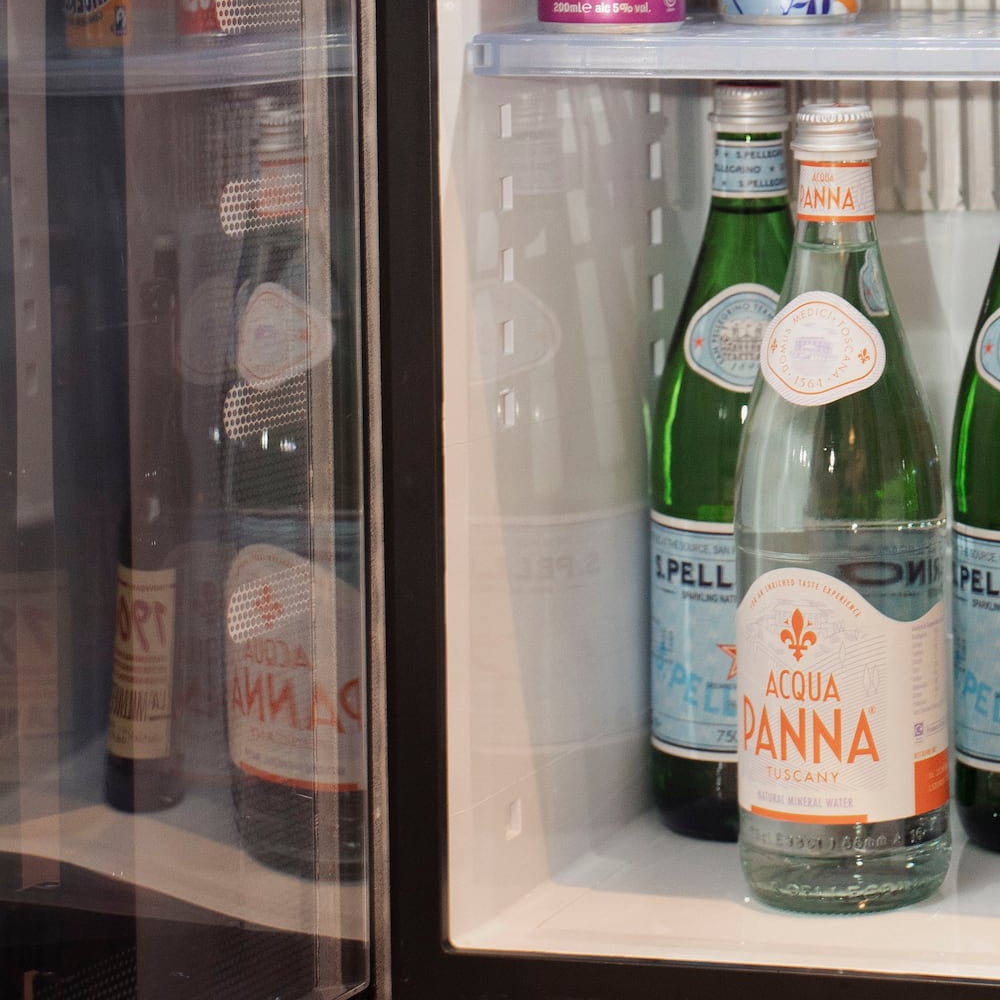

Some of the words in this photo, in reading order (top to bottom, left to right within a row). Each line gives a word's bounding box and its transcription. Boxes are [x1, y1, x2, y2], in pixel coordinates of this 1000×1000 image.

[595, 3, 611, 13] alc
[612, 2, 633, 13] 5%
[812, 172, 834, 183] ACQUA
[792, 307, 833, 325] MEDICI
[793, 375, 824, 389] 1564
[765, 668, 841, 702] ACQUA
[743, 695, 881, 764] PANNA
[767, 765, 840, 784] TUSCANY
[757, 790, 786, 806] NATURAL
[787, 793, 823, 809] MINERAL
[826, 796, 854, 809] WATER
